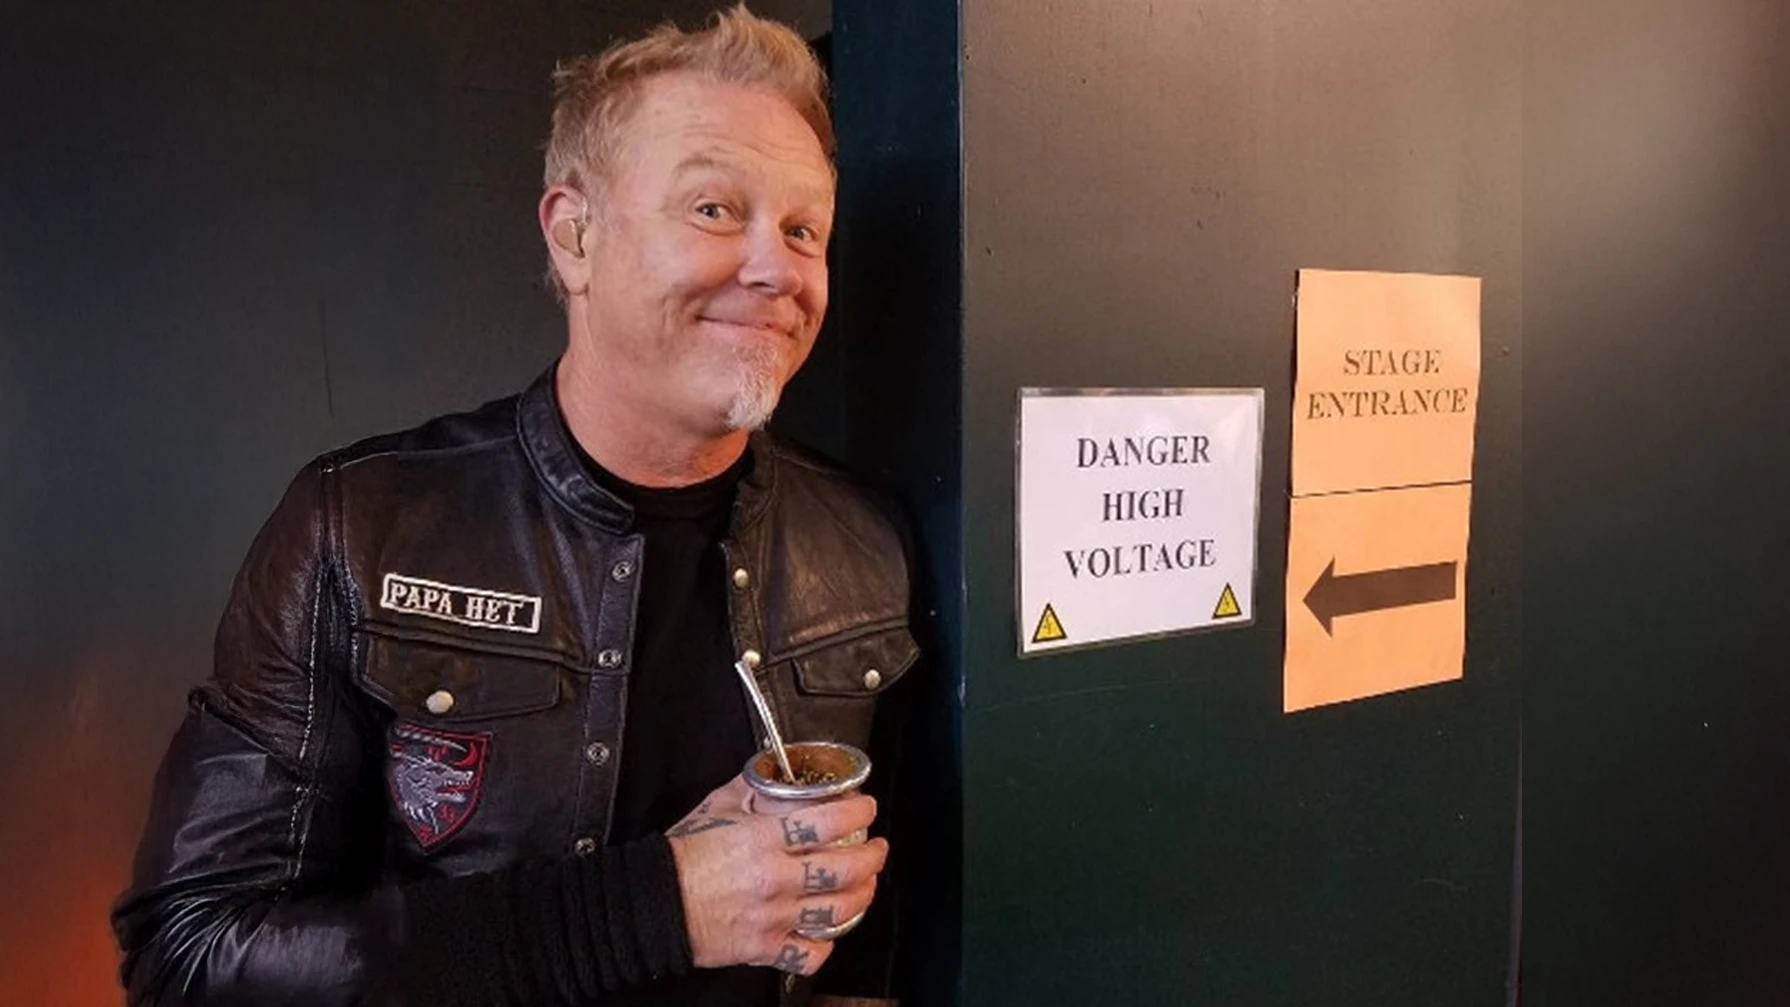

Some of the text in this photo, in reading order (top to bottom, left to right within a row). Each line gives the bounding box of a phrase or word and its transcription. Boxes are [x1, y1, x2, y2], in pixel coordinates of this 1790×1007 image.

[1343, 349, 1440, 376] STAGE
[1306, 387, 1469, 420] ENTRANCE
[1076, 435, 1211, 469] DANGER
[1101, 488, 1185, 523] HIGH
[1063, 538, 1217, 579] VOLTAGE
[390, 582, 525, 625] PAPA HET
